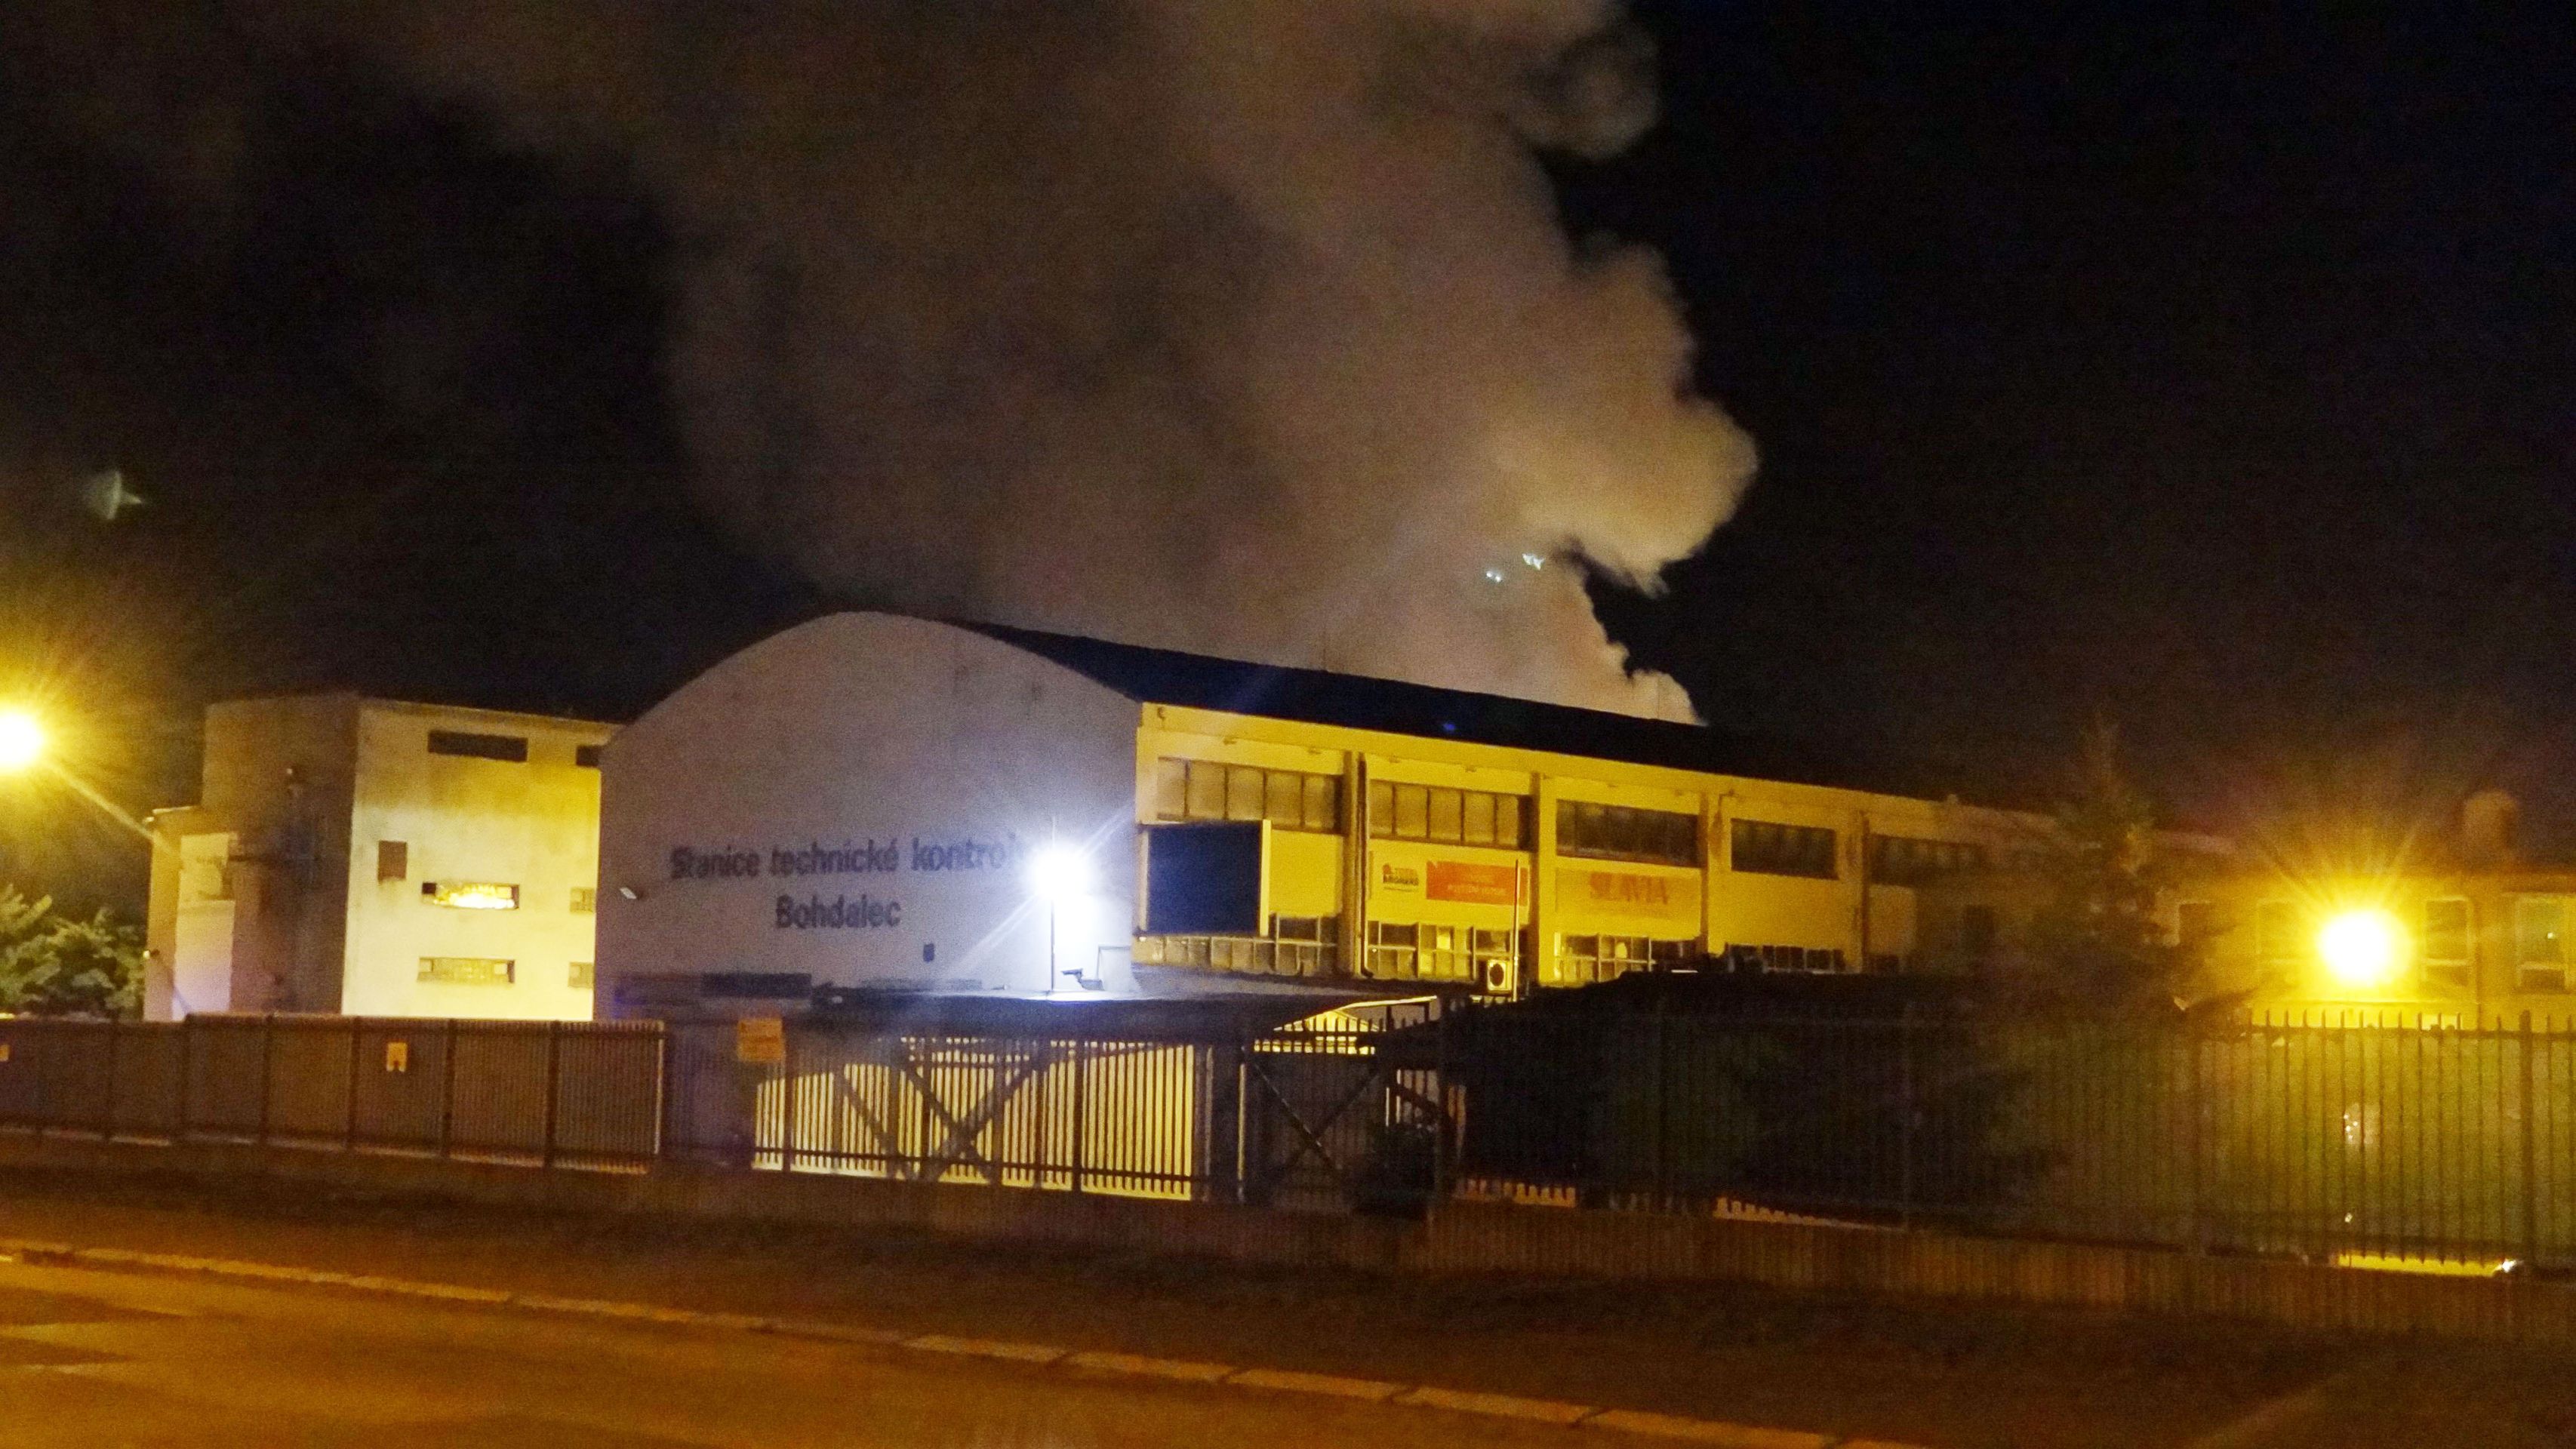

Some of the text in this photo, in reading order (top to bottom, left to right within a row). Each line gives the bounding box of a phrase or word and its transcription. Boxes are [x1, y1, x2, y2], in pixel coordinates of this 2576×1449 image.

[670, 845, 759, 879] Stanice
[771, 838, 898, 875] technické
[775, 894, 901, 929] Bohdalec
